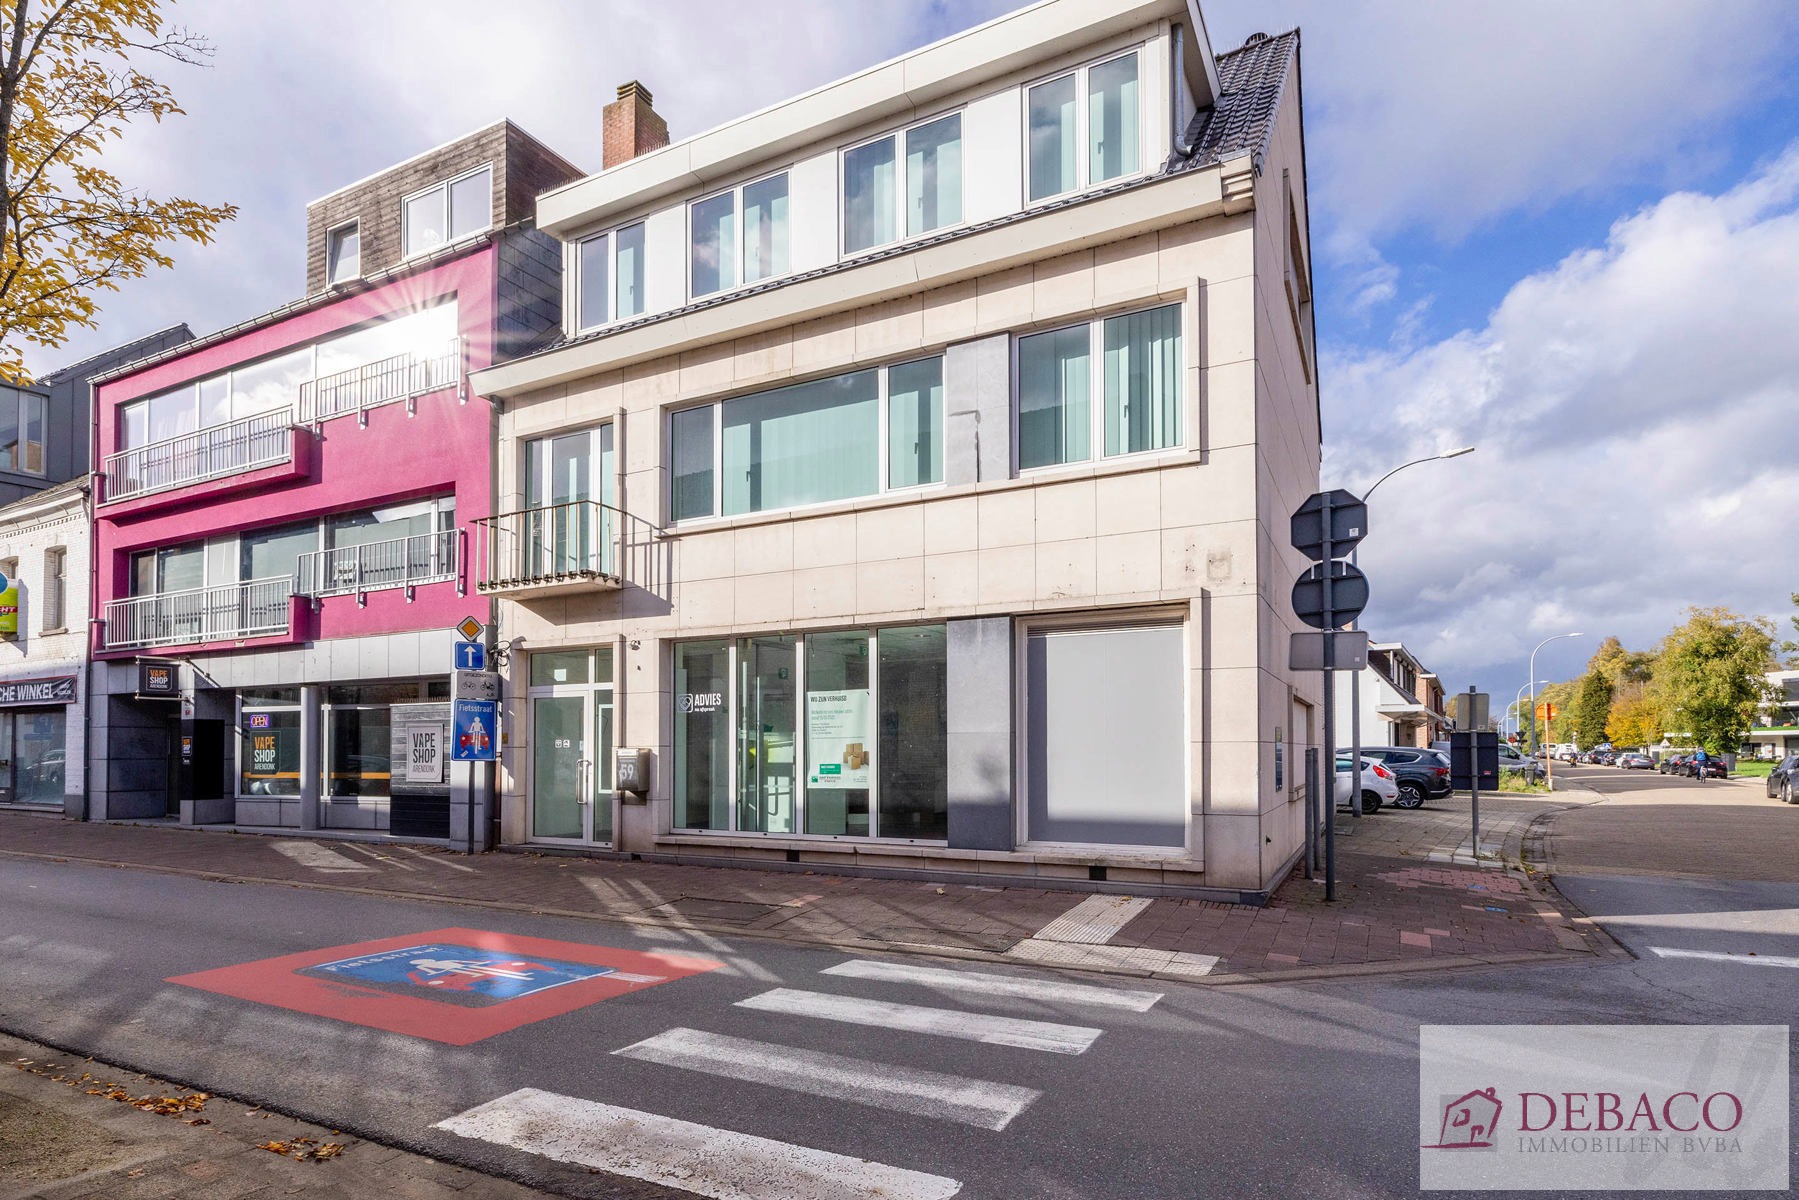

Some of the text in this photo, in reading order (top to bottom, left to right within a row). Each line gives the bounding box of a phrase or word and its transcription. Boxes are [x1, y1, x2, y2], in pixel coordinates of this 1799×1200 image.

[149, 669, 168, 677] VAPE
[149, 676, 169, 685] SHOP
[17, 683, 54, 701] WINKEL
[694, 693, 722, 706] ADVIES
[459, 703, 493, 713] Fietsstraat
[251, 716, 268, 726] OPEN
[254, 736, 276, 750] VAPE
[412, 732, 436, 748] VAPE
[254, 749, 276, 763] SHOP
[412, 748, 436, 764] SHOP
